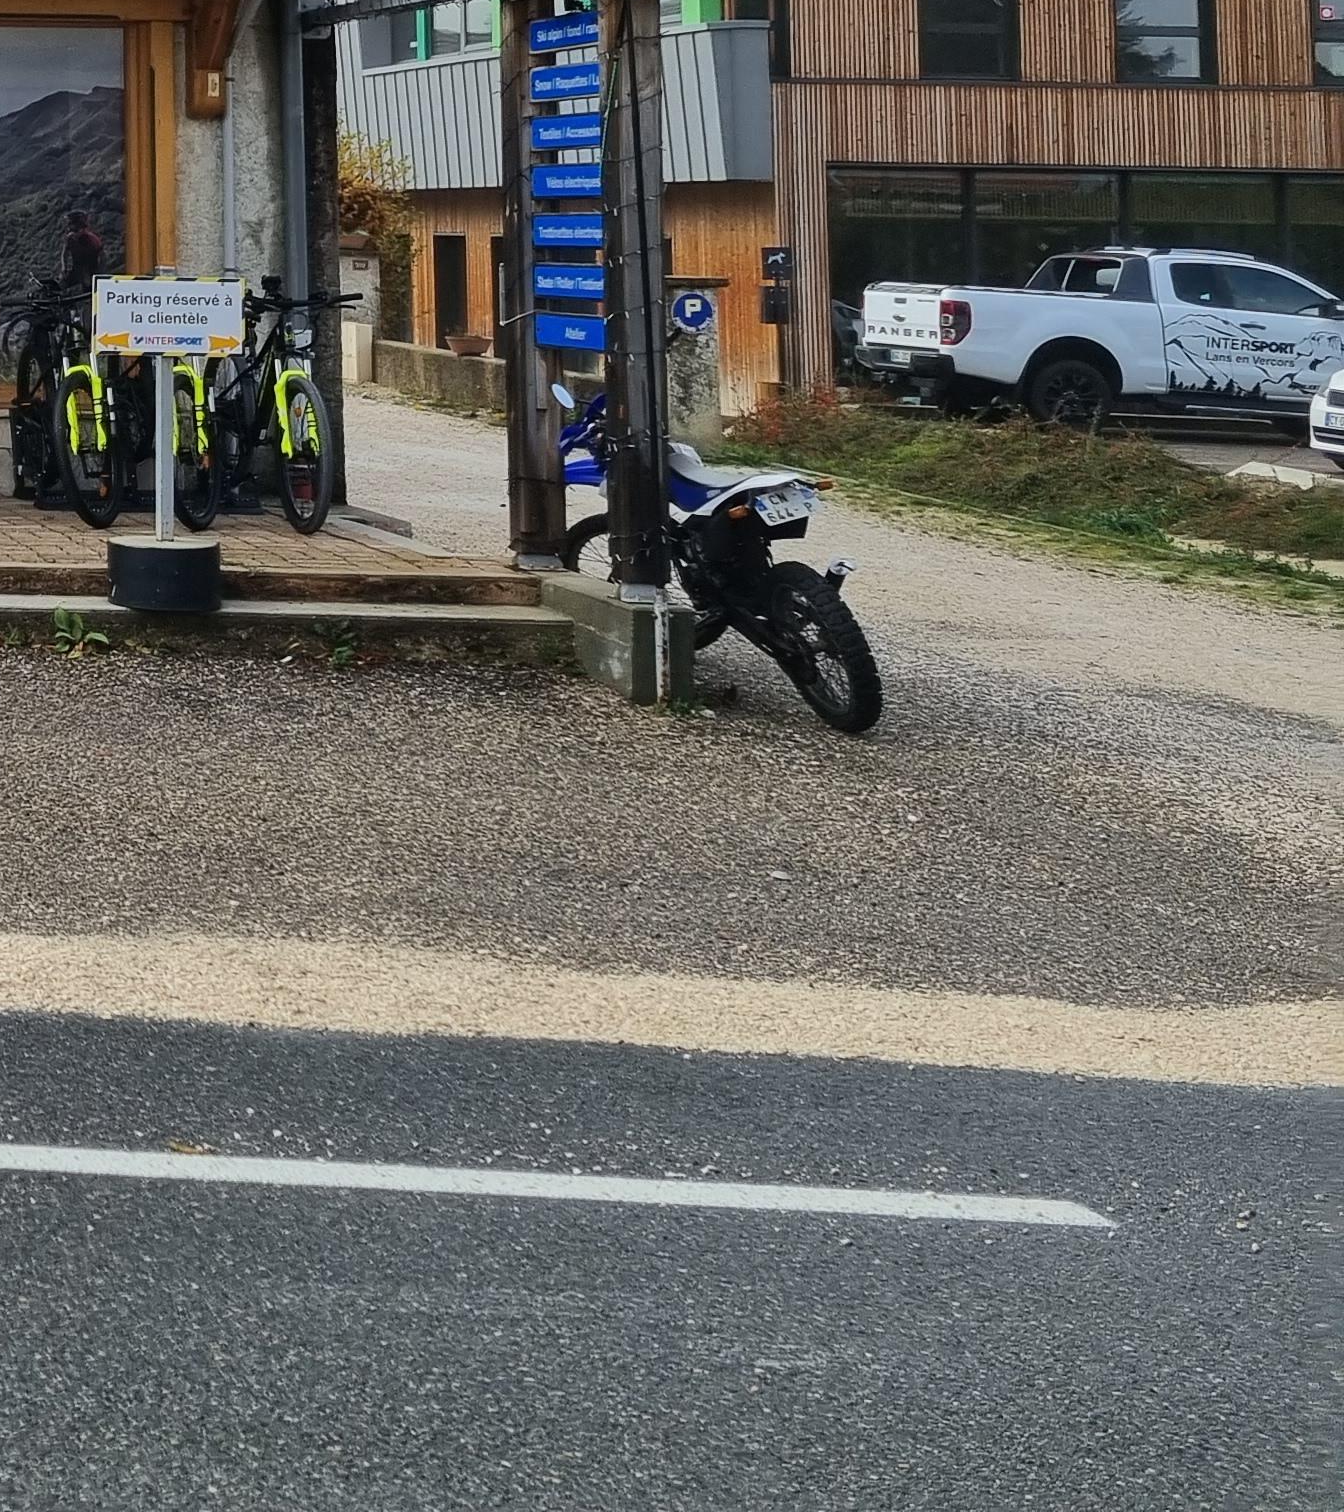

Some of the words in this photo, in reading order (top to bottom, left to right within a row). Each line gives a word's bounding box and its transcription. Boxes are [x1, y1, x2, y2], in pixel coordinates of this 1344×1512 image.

[106, 291, 162, 307] Parking
[166, 293, 220, 306] réservé
[224, 294, 233, 306] à
[684, 299, 701, 318] P
[131, 312, 143, 324] la
[147, 312, 209, 325] clientèle
[867, 325, 938, 339] RANGER
[145, 336, 203, 346] INTERSPORT
[1206, 336, 1296, 355] INTERSPORT
[1205, 352, 1232, 362] Lans
[1235, 355, 1250, 363] en
[1253, 356, 1295, 367] Vercors
